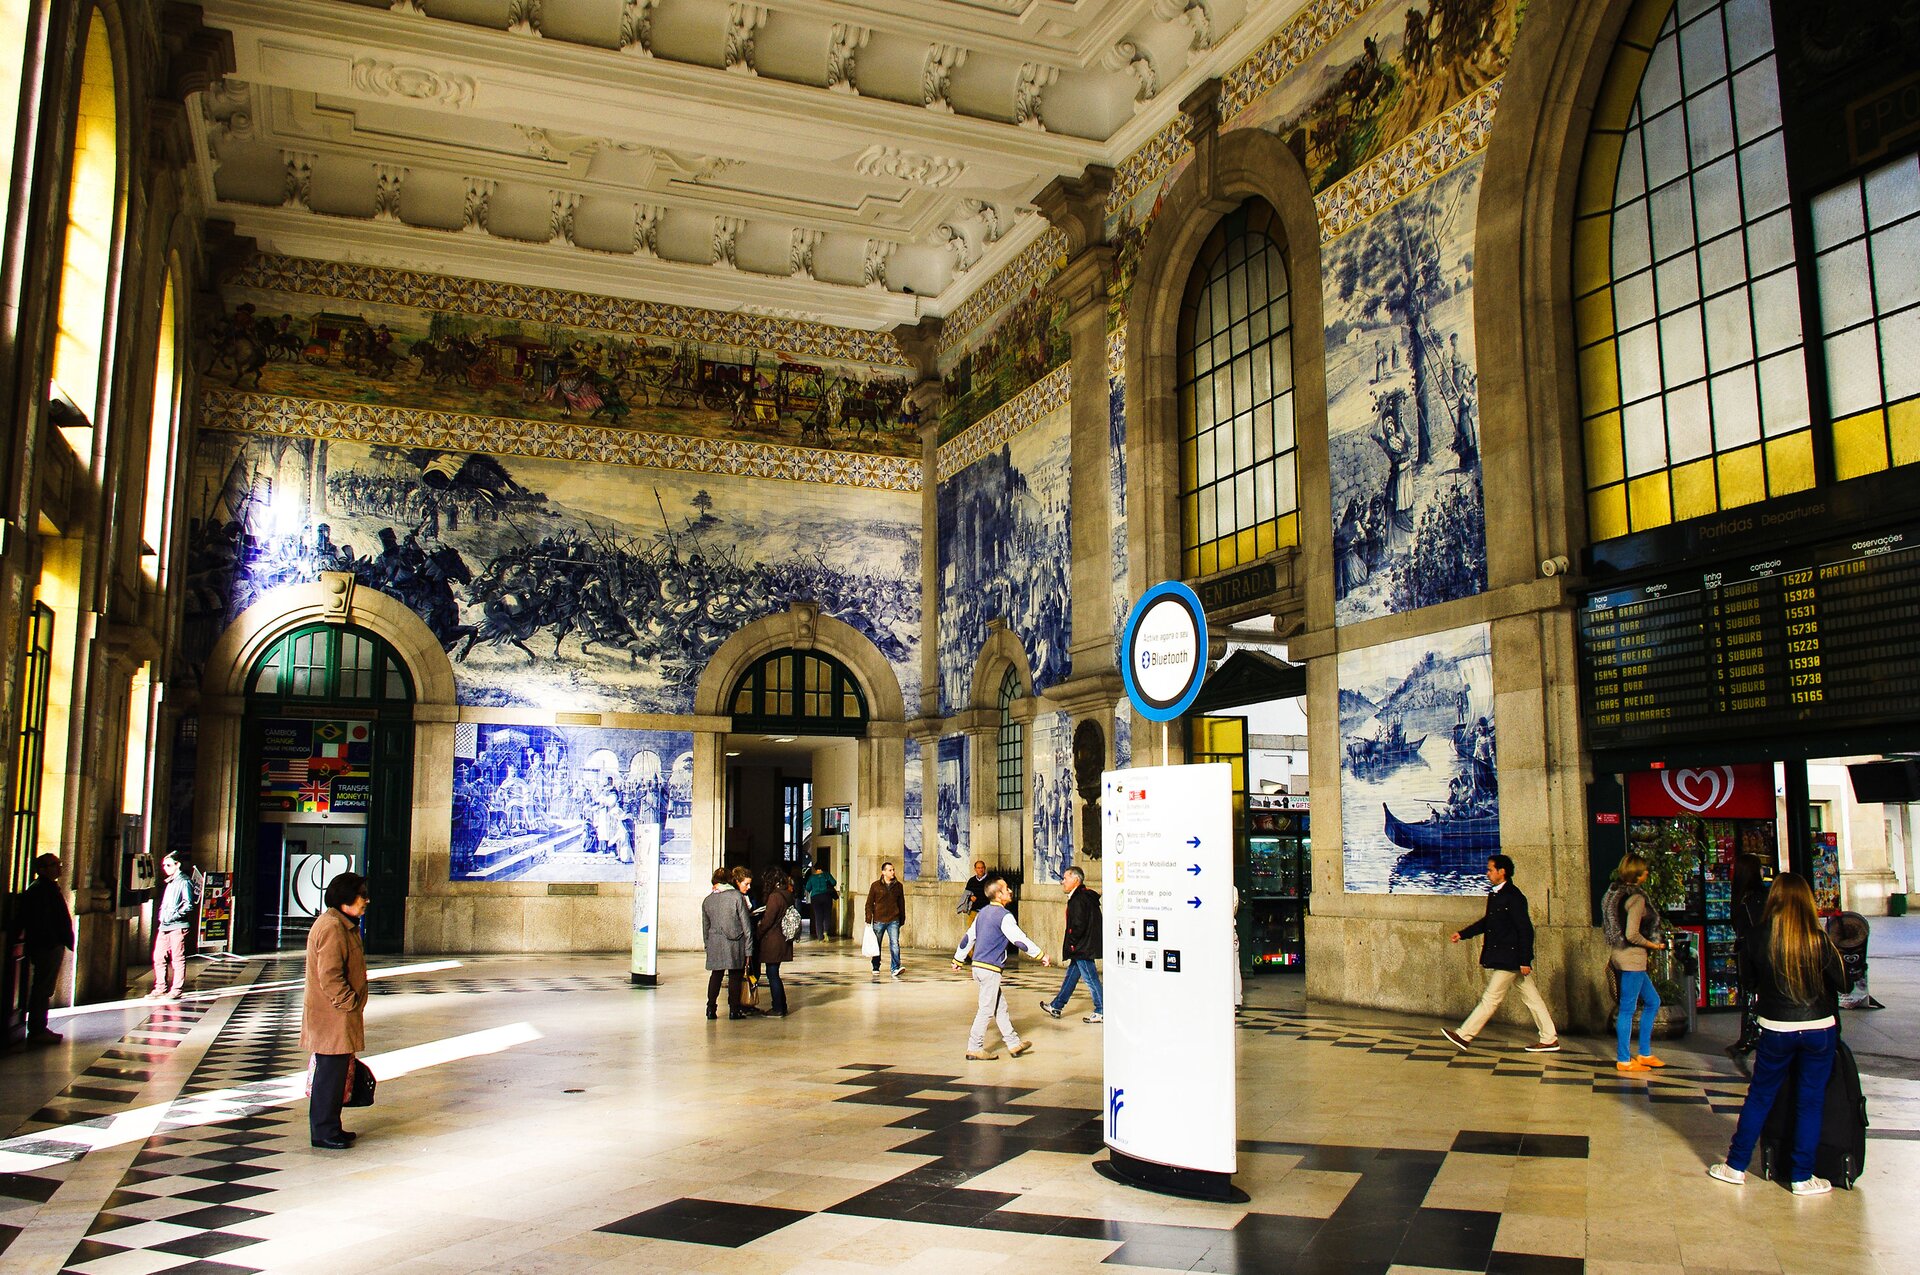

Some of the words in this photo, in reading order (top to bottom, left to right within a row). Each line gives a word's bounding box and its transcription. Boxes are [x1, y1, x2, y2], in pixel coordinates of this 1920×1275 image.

[1699, 517, 1753, 539] Partidas
[1761, 502, 1825, 526] Departures
[1852, 533, 1903, 550] observações
[1864, 545, 1891, 556] remarks
[1704, 572, 1722, 582] linha
[1750, 559, 1782, 572] comboio
[1205, 567, 1271, 606] ENTRADA
[1645, 583, 1668, 593] destino
[1705, 580, 1722, 589] track
[1723, 582, 1758, 598] SUBURB
[1783, 572, 1814, 586] 15227
[1819, 560, 1866, 580] PARTIDA
[1620, 620, 1640, 631] OVAR
[1713, 605, 1719, 616] 6
[1724, 598, 1759, 614] SUBURB
[1784, 588, 1815, 603] 15928
[1714, 621, 1720, 631] 4
[1725, 614, 1761, 630] SUBURB
[1785, 605, 1816, 619] 15531
[1622, 649, 1652, 661] AVEIRO
[1716, 637, 1721, 647] 5
[1727, 631, 1762, 646] SUBURB
[1786, 622, 1818, 636] 15736
[1717, 653, 1723, 663] 3
[1728, 647, 1763, 662] SUBURB
[1787, 638, 1819, 653] 15229
[1151, 650, 1188, 666] Bluetooth
[1623, 680, 1643, 692] OVAR
[1718, 669, 1724, 679] 5
[1729, 664, 1765, 678] SUBURB
[1789, 655, 1821, 670] 15930
[1624, 694, 1655, 707] AVEIRO
[1719, 685, 1725, 695] 4
[1730, 680, 1766, 694] SUBURB
[1790, 672, 1822, 687] 15738
[1720, 701, 1726, 712] 3
[1731, 696, 1767, 711] SUBURB
[1791, 689, 1824, 704] 15165
[265, 737, 295, 745] CHANGE
[1146, 831, 1162, 839] Porto
